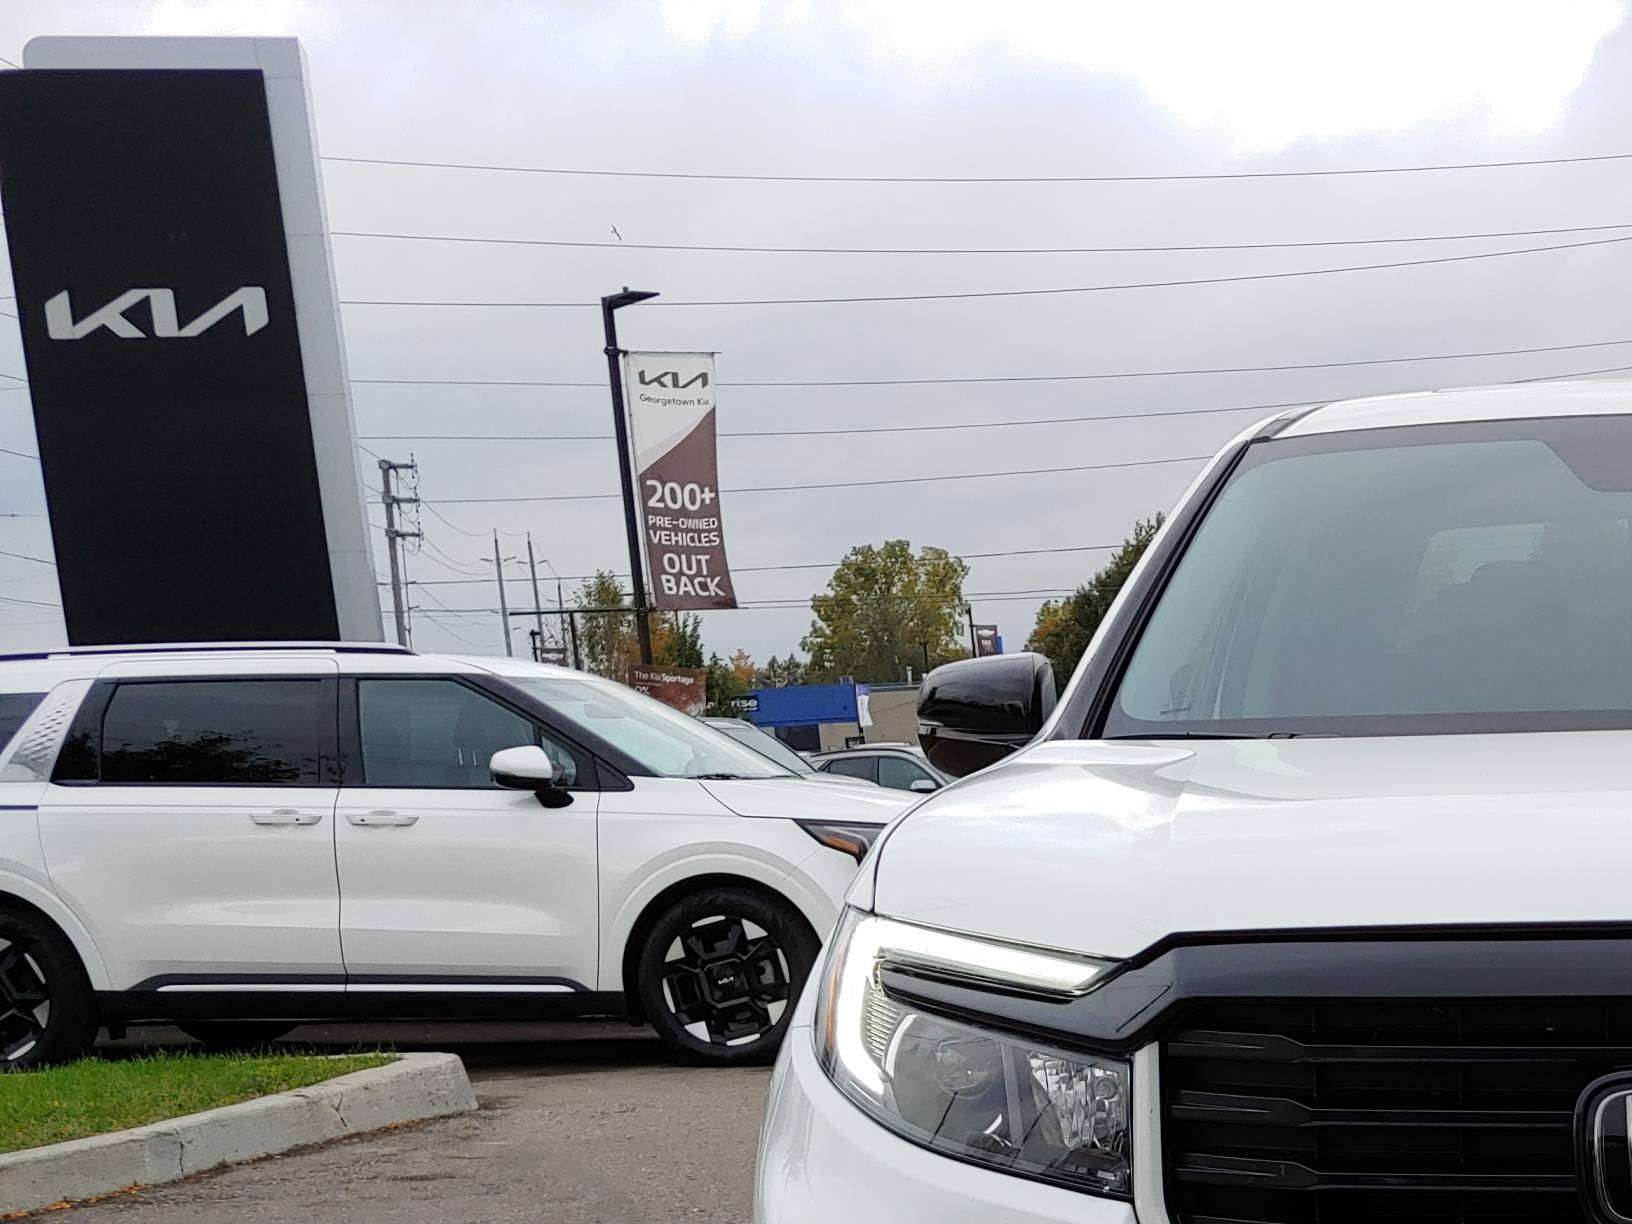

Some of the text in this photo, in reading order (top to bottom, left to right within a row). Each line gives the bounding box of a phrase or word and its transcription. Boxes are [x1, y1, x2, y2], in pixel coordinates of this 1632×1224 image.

[639, 393, 695, 407] Georgetown
[646, 479, 716, 511] 200+
[648, 515, 718, 530] PRE-OWNED
[649, 529, 720, 546] VEHICLES
[662, 552, 711, 576] OUT
[660, 574, 727, 597] BACK
[634, 670, 649, 680] The
[661, 673, 695, 687] Sportage
